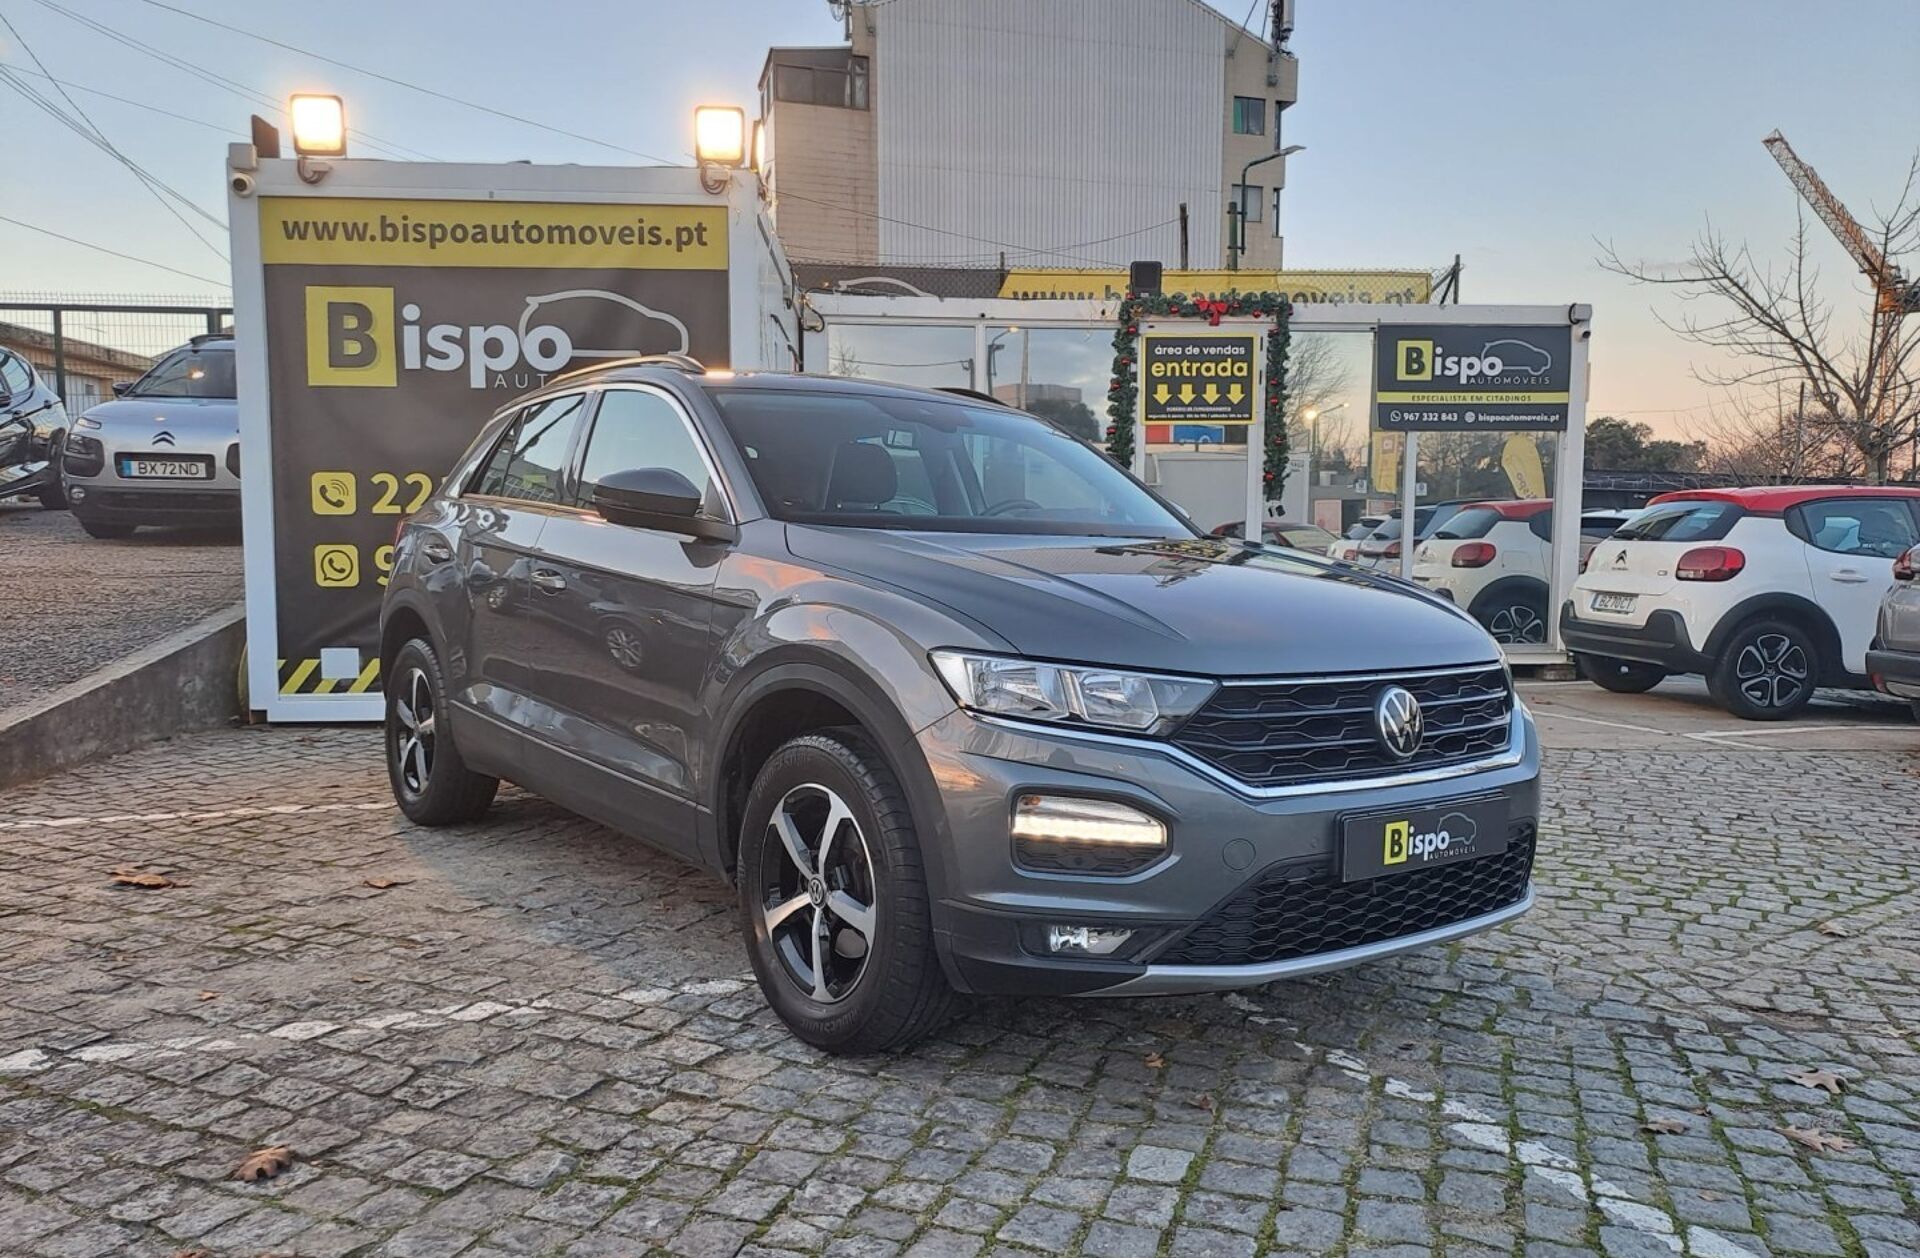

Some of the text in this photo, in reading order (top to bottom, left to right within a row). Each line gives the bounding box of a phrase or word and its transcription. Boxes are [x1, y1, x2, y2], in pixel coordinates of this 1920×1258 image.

[282, 215, 709, 252] www.bispoautomoveis.pt
[327, 300, 573, 389] Bispo
[1155, 345, 1246, 355] área de vendas
[1151, 358, 1248, 377] entrada
[1405, 346, 1503, 384] Bispo
[1403, 412, 1419, 421] 967
[1422, 412, 1438, 421] 332
[1389, 825, 1450, 861] Bispo
